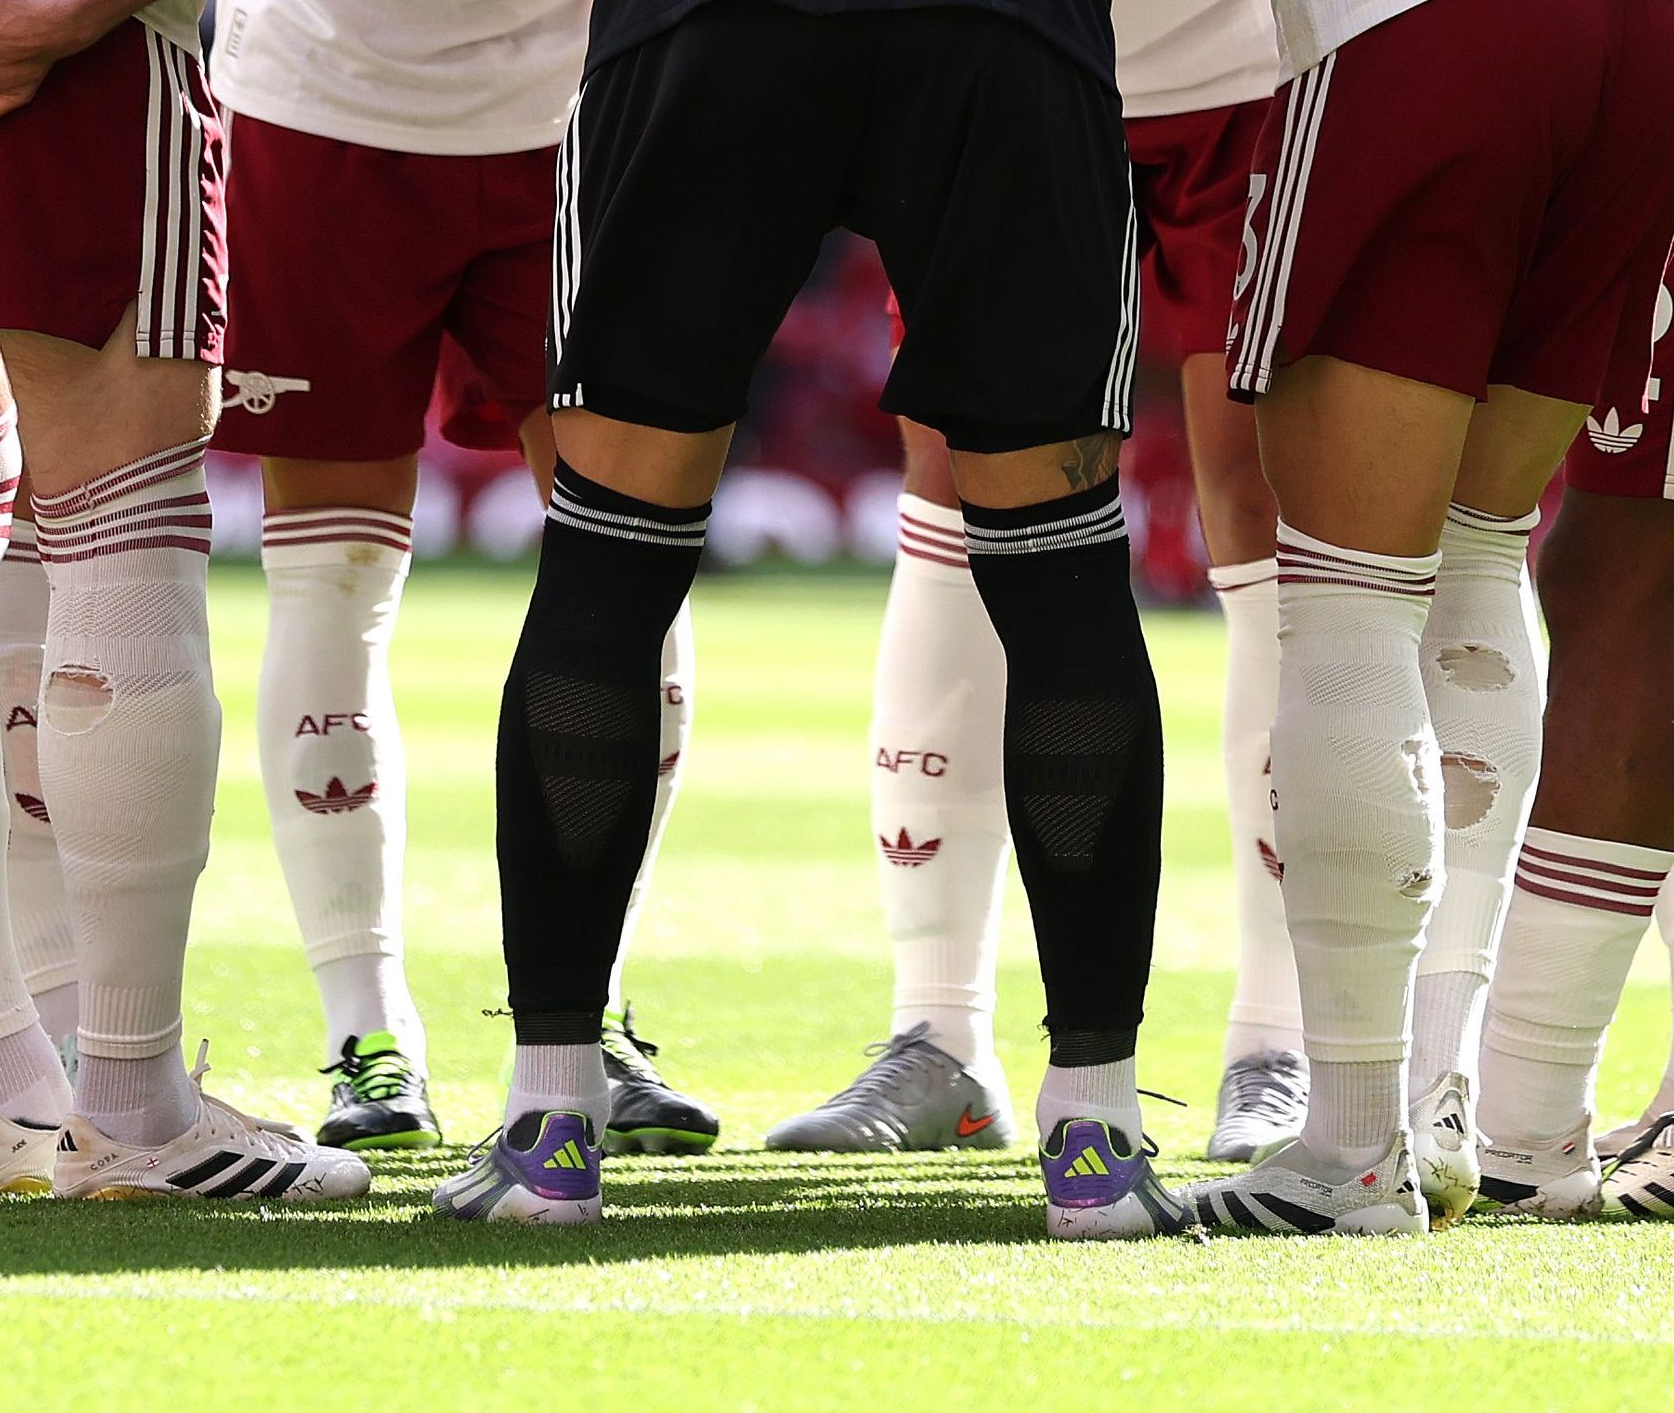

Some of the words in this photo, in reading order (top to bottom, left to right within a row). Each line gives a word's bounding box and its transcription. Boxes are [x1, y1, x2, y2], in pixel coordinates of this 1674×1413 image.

[295, 713, 372, 737] AFC
[876, 747, 949, 777] AFC
[89, 1152, 120, 1172] COPA
